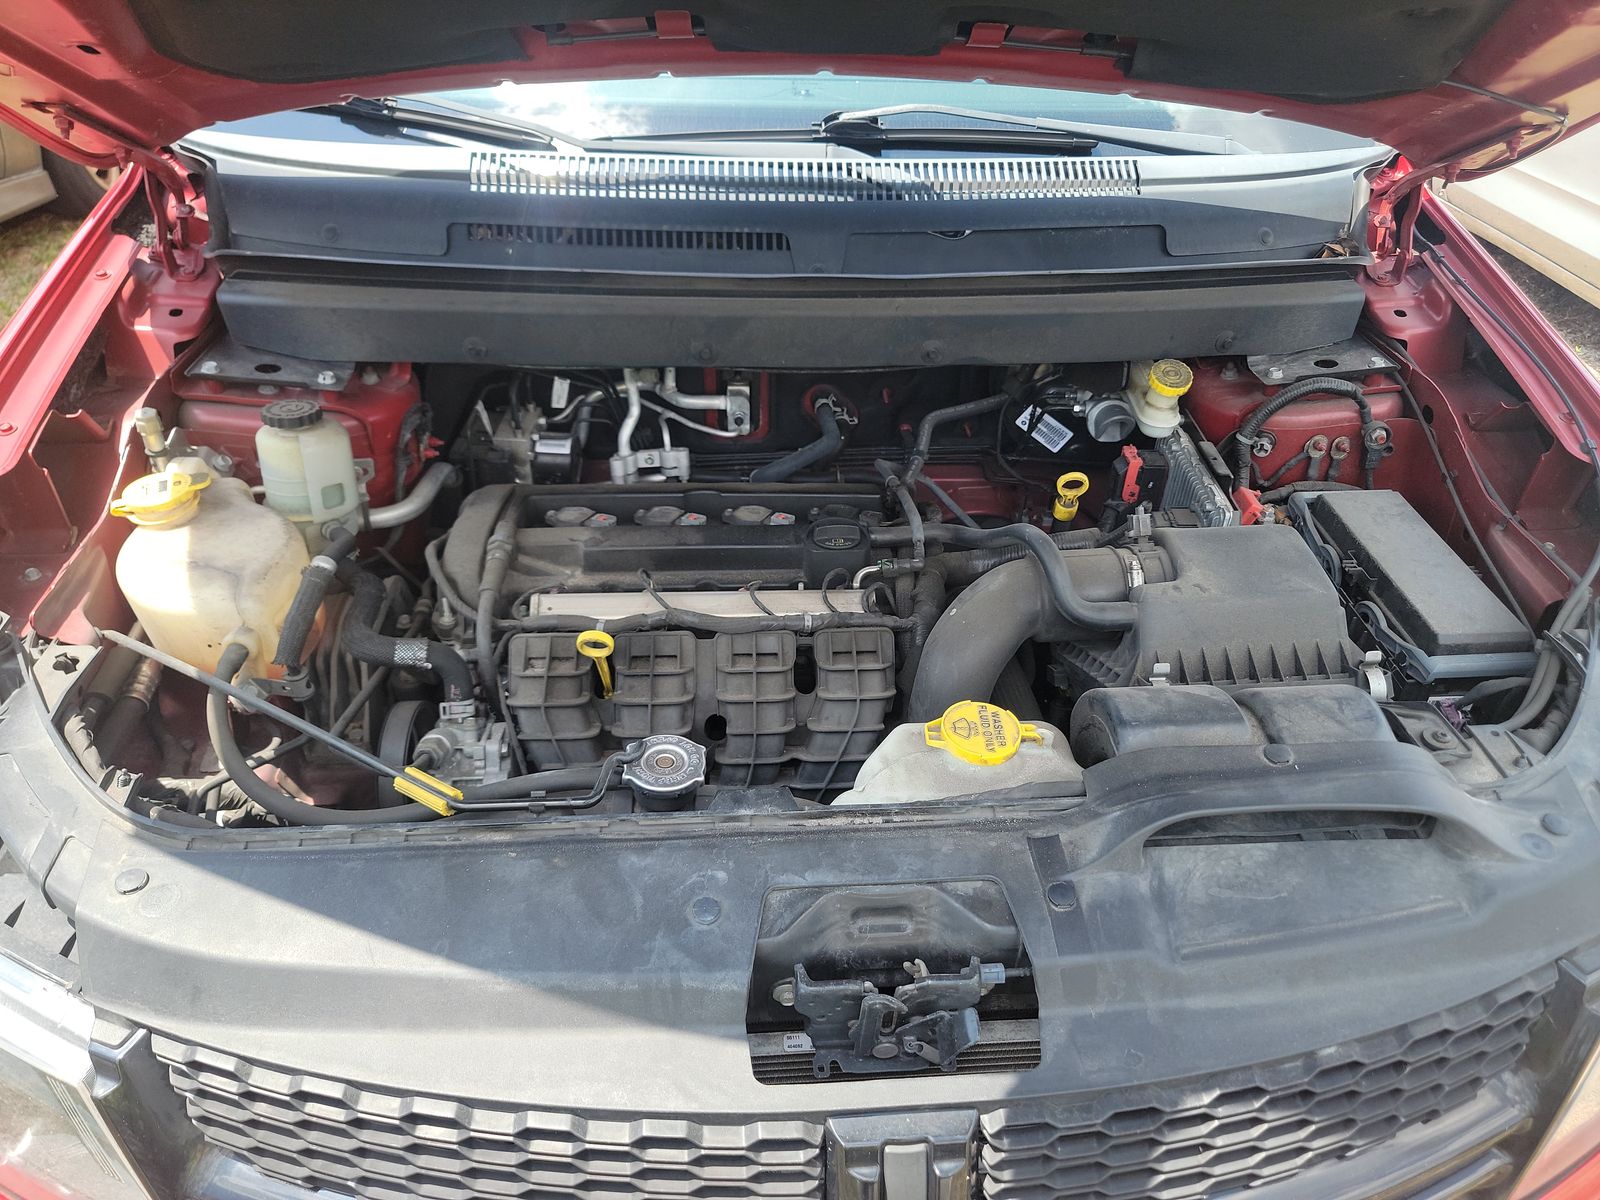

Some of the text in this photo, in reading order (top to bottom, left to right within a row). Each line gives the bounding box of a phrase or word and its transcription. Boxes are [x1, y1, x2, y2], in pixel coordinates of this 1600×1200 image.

[978, 705, 996, 753] FLUID ONLY
[991, 711, 1007, 746] WASHER
